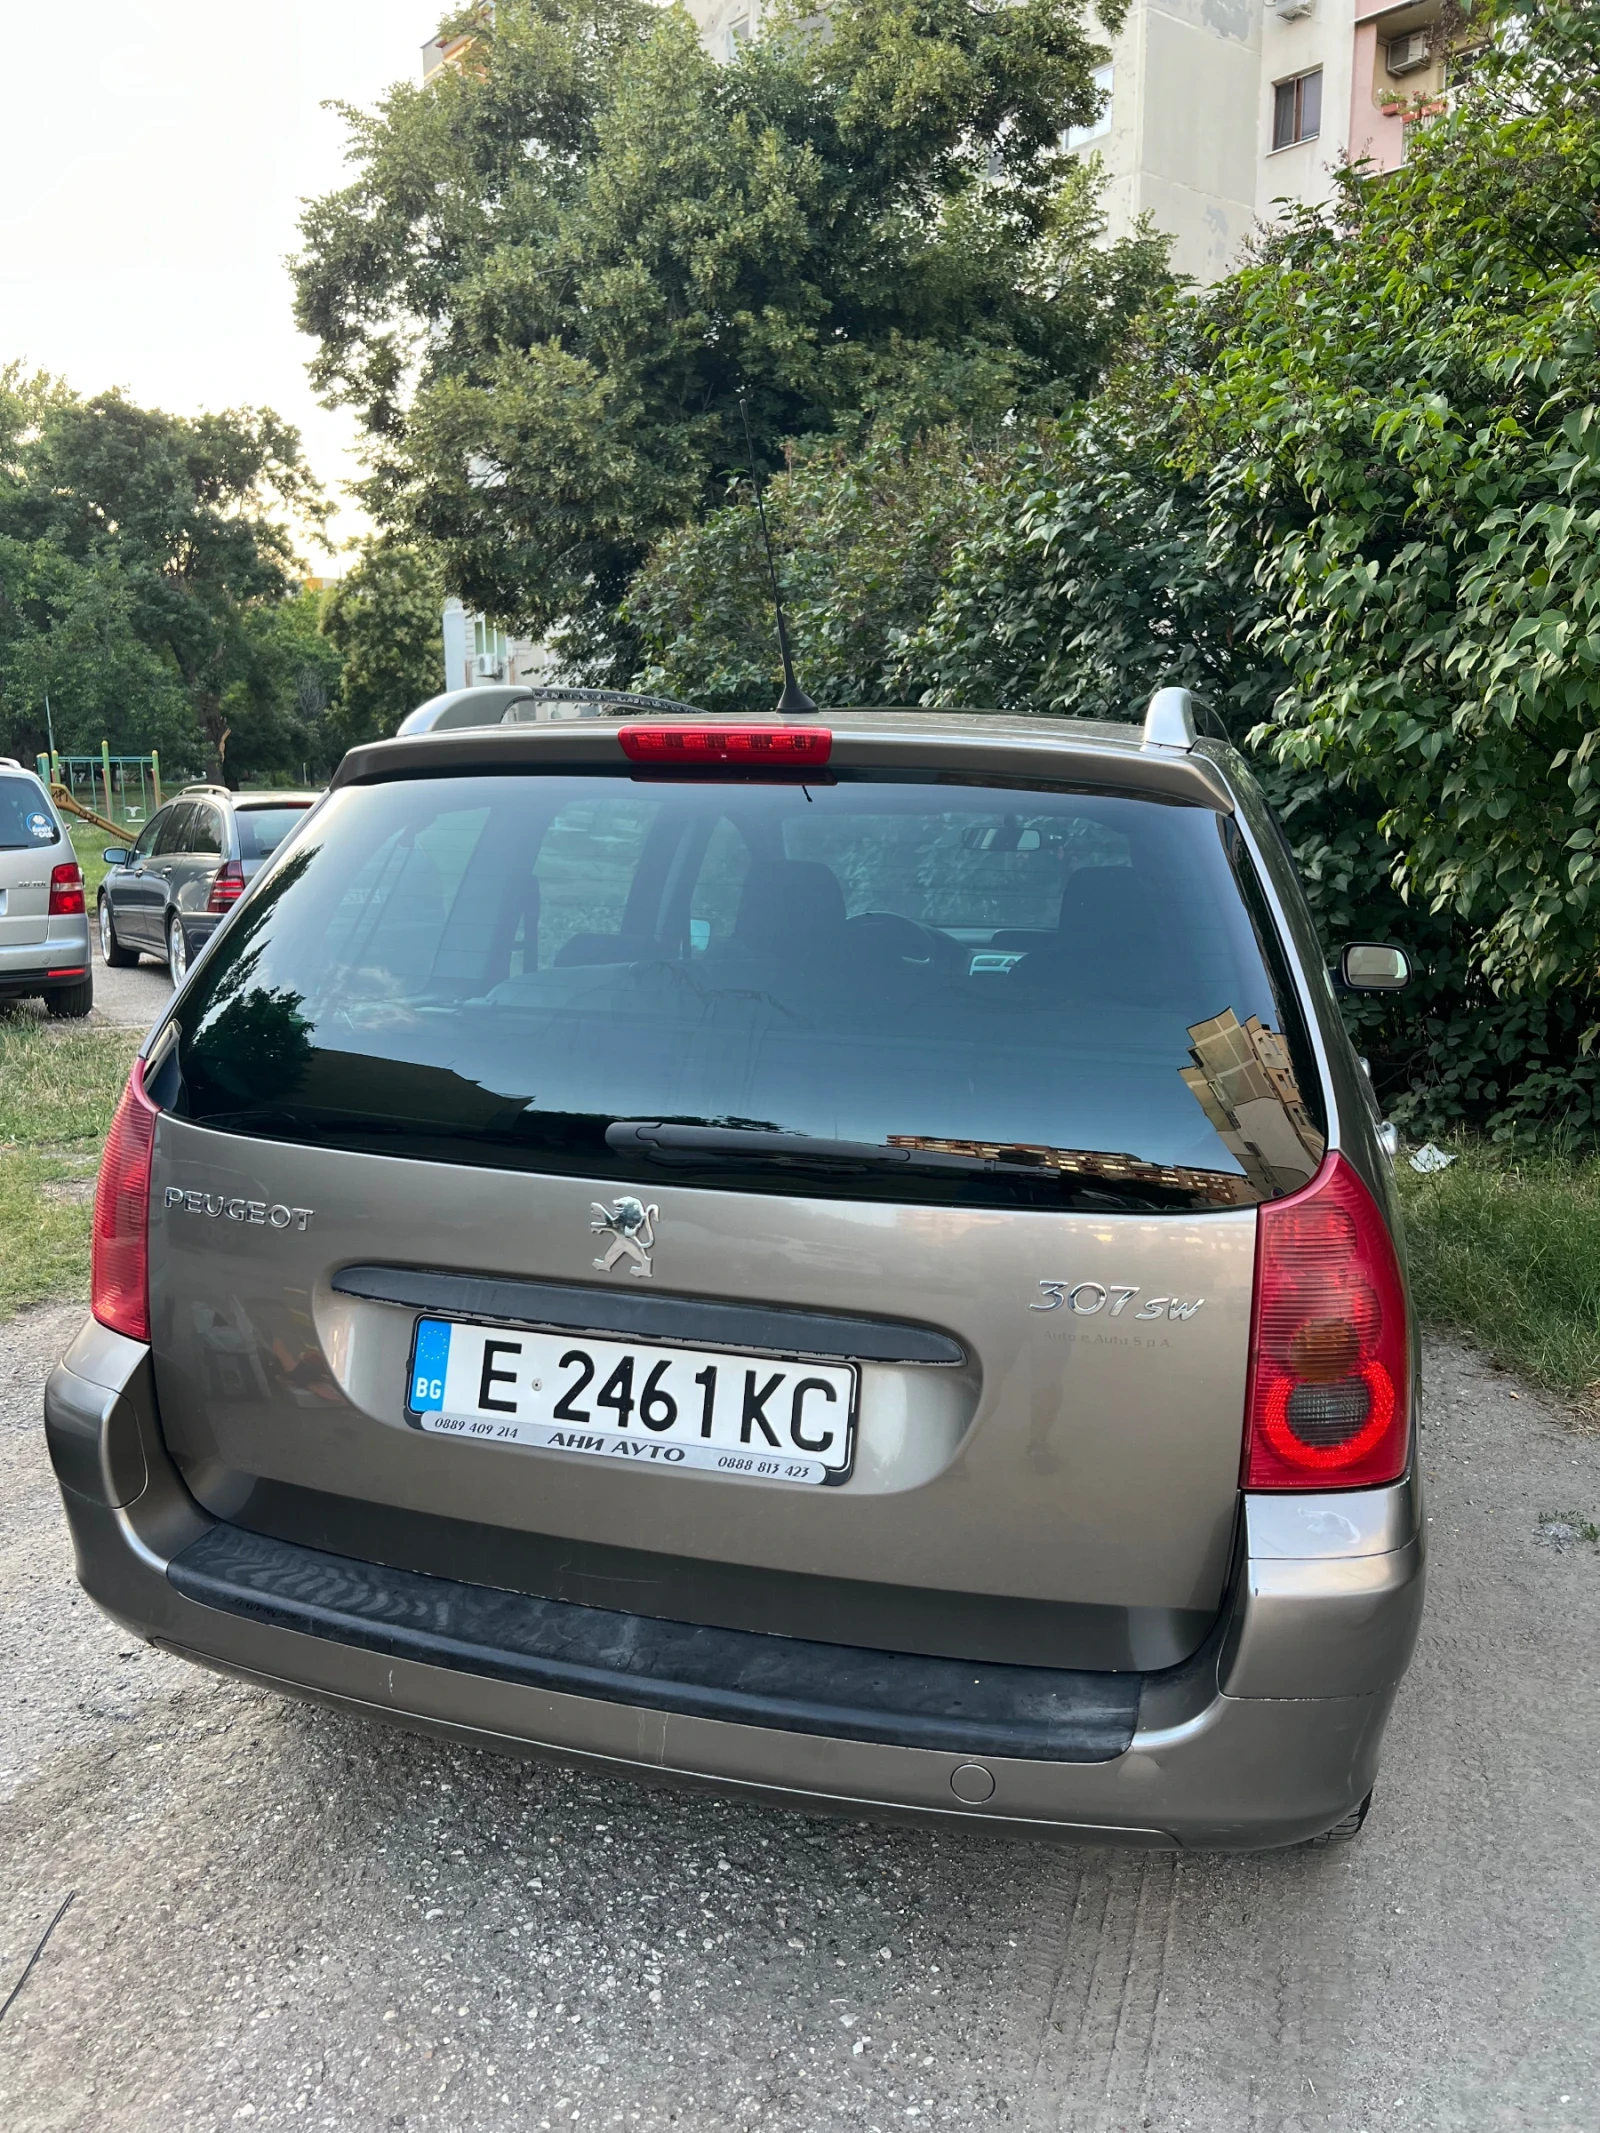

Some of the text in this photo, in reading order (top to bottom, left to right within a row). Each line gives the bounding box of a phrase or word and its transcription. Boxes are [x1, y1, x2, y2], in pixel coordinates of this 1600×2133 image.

[164, 1186, 316, 1231] PEUGEOT
[1029, 1280, 1141, 1317] 307
[416, 1377, 442, 1400] BG
[478, 1339, 837, 1452] E 2461 KC
[435, 1417, 518, 1439] 0889 409 214
[548, 1432, 604, 1451] АНИ
[718, 1456, 810, 1478] 0888 813 423
